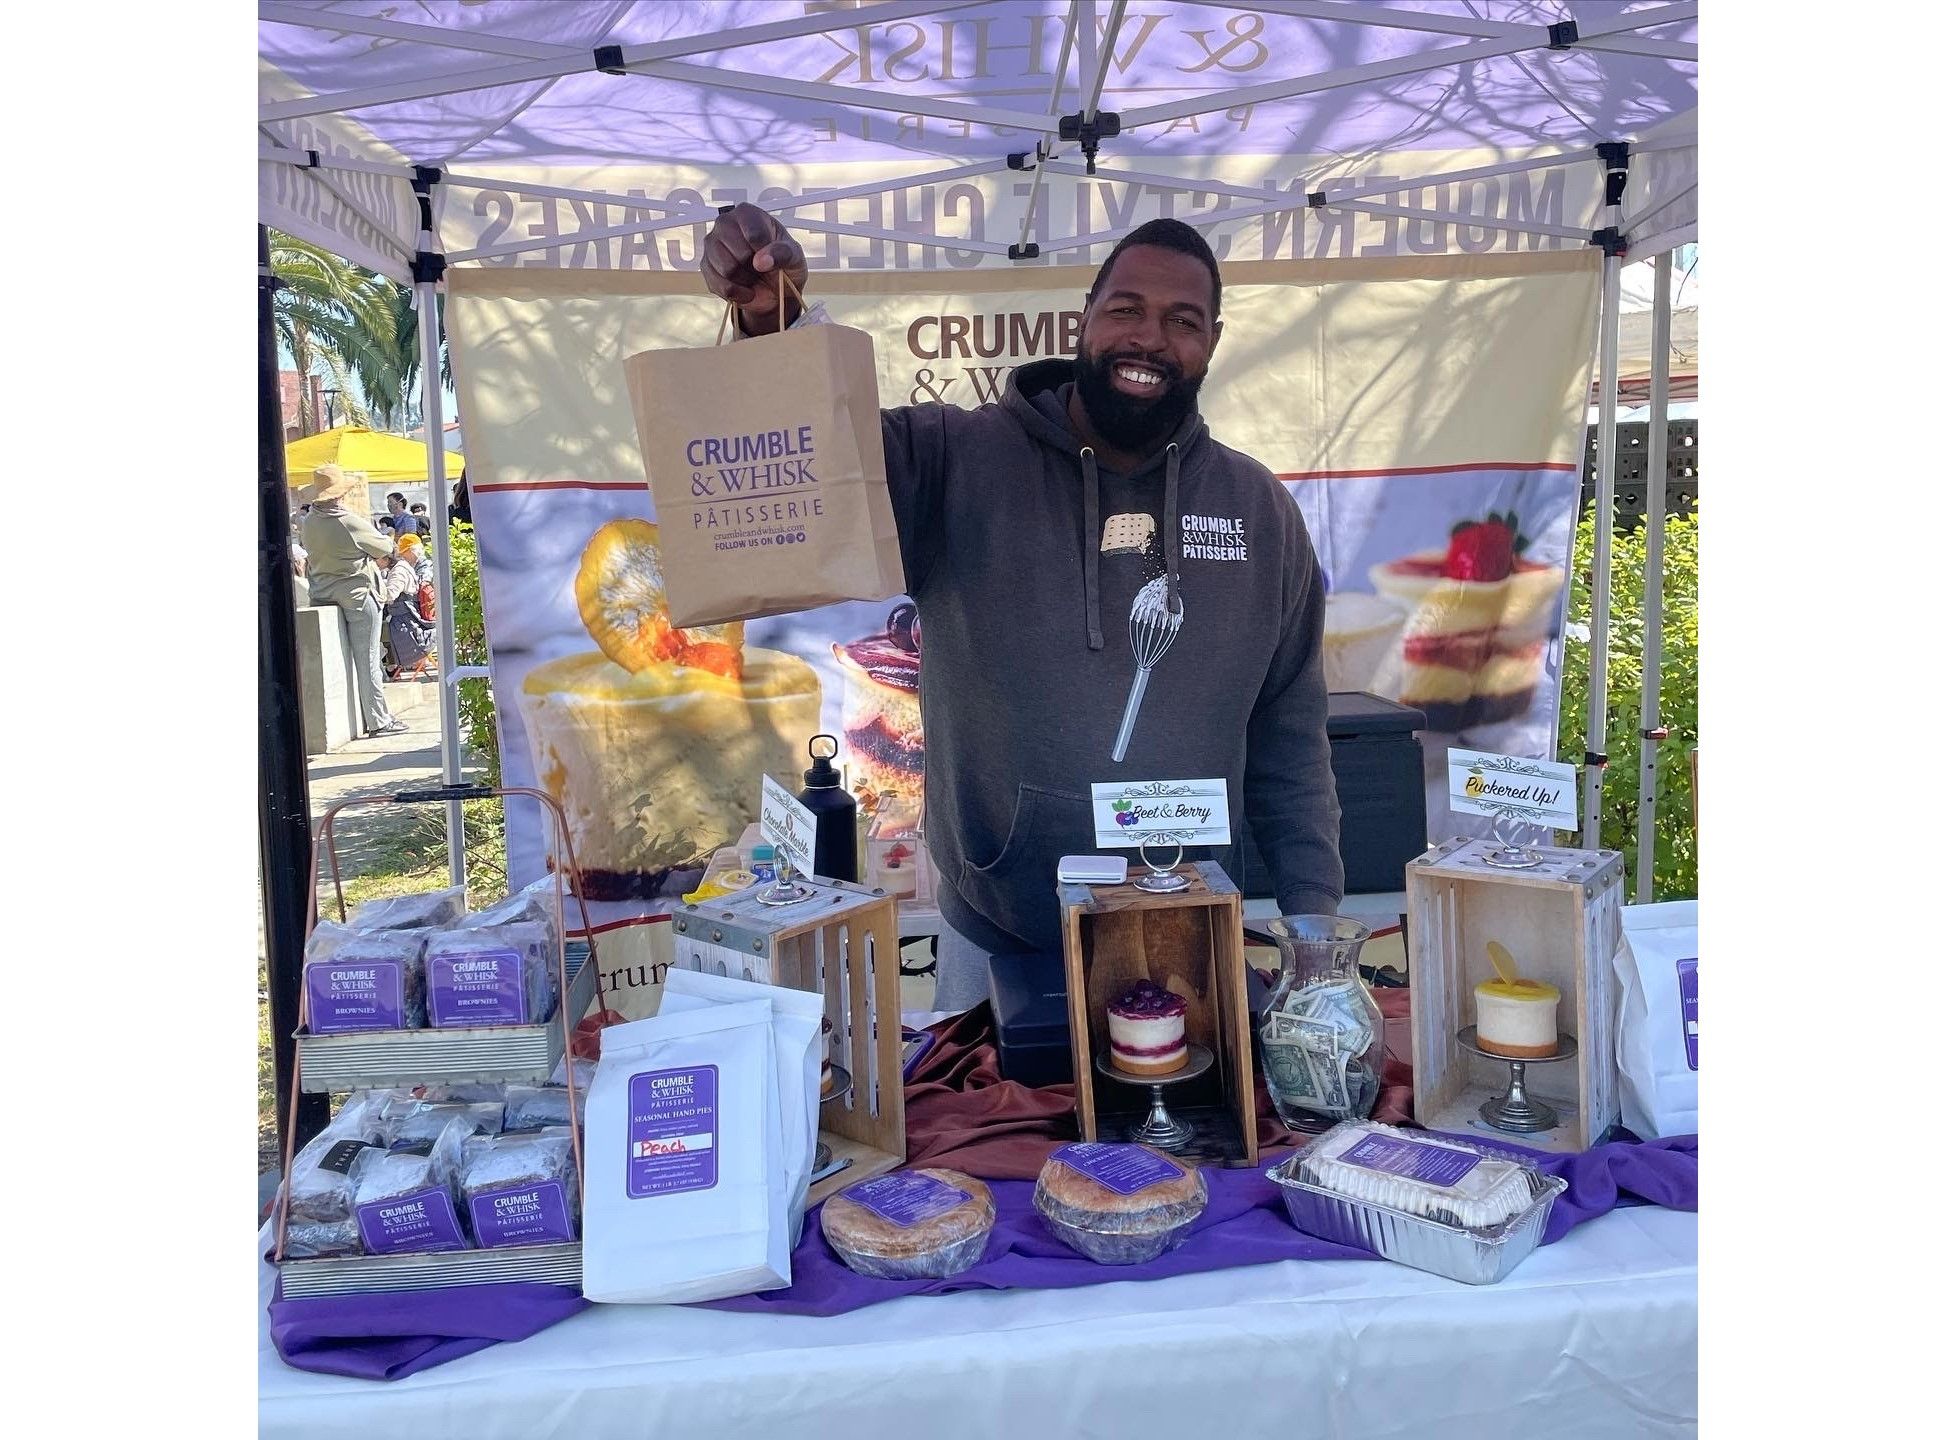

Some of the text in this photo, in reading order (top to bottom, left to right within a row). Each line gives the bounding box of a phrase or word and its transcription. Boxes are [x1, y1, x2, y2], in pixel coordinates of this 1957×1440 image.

[686, 425, 814, 467] CRUMBLE
[691, 458, 819, 497] & WHISK
[693, 499, 824, 529] PÂTISSERIE
[1181, 514, 1245, 534] CRUMBLE
[713, 524, 806, 541] crumbleandwhisk.com
[715, 536, 773, 551] FOLLOW US ON
[1183, 544, 1248, 561] PÂTISSERIE
[1465, 776, 1560, 806] Puckered Up!
[1132, 803, 1212, 824] Beet & Berry
[452, 960, 498, 973] CRUMBLE
[330, 970, 376, 981] CRUMBLE
[453, 971, 498, 982] & WHISK
[330, 980, 377, 991] & WHISK
[457, 998, 498, 1006] BROWNIES
[335, 1007, 376, 1015] BROWNIES
[651, 1075, 694, 1089] CRUMBLE
[651, 1085, 694, 1099] & WHISK
[634, 1106, 713, 1123] SEASONAL HAND PIES
[640, 1139, 686, 1157] Peach
[494, 1192, 539, 1208] CRUMBLE
[379, 1201, 425, 1219] CRUMBLE
[496, 1203, 541, 1217] & WHISK
[382, 1211, 428, 1227] & WHISK
